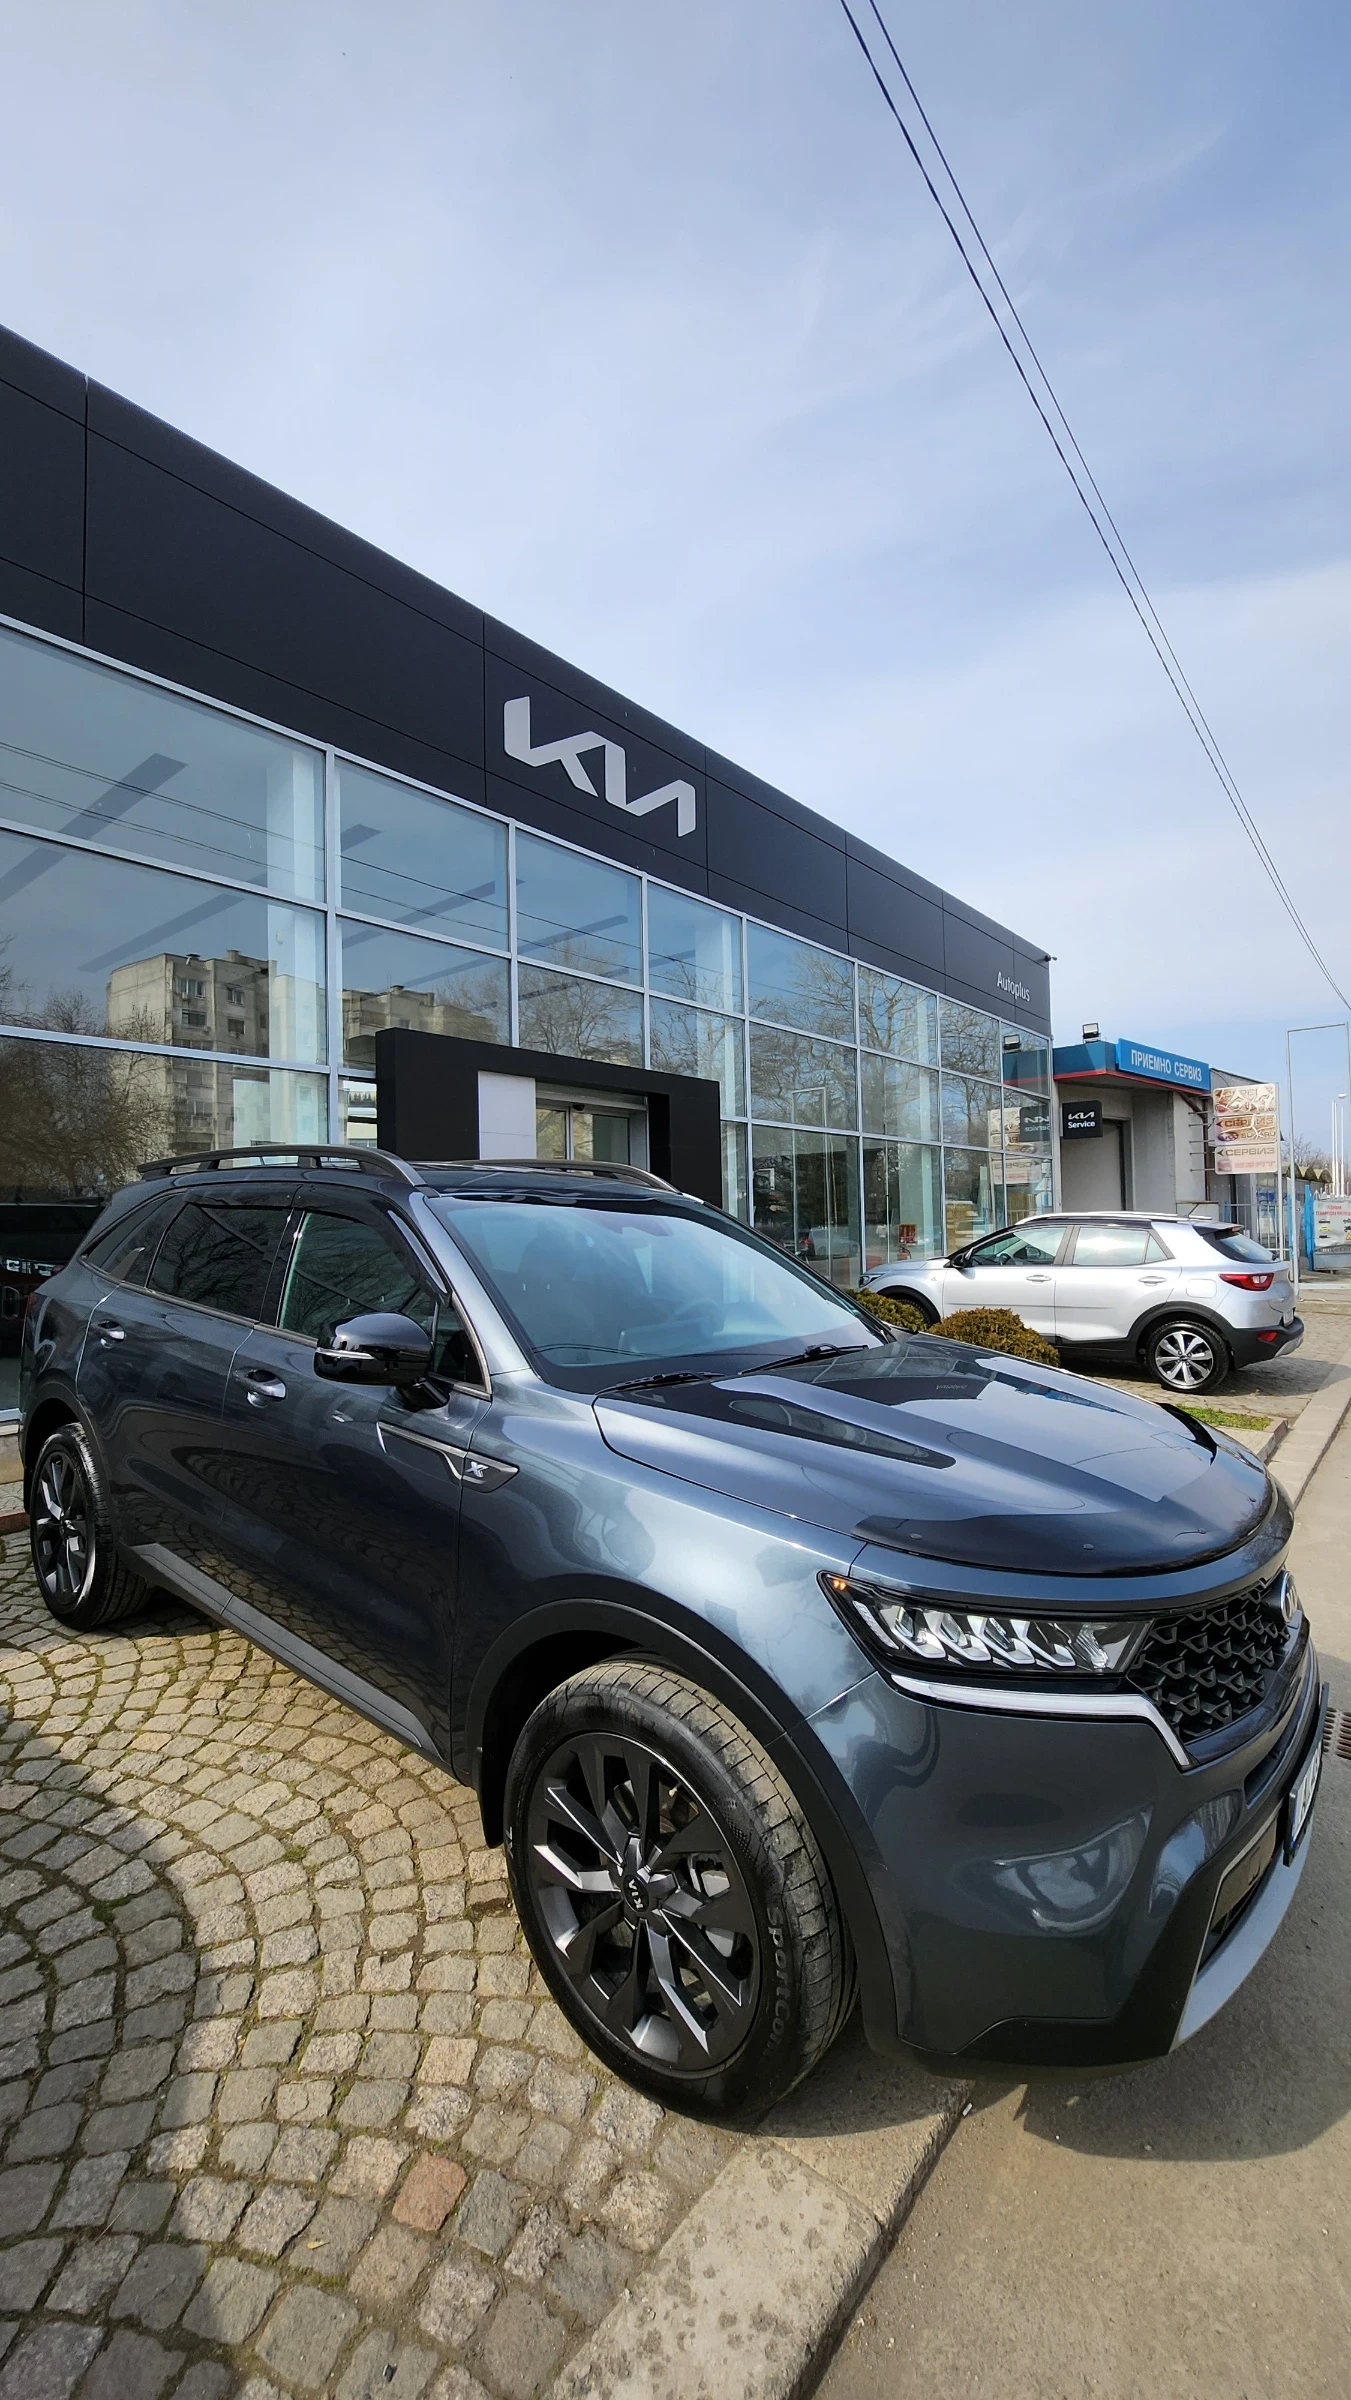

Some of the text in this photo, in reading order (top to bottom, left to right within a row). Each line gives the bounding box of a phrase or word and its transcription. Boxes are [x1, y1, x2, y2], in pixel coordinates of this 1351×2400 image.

[504, 696, 696, 838] KIA
[997, 971, 1030, 1002] Autoplus
[1131, 1049, 1202, 1082] ПРИЕМНО СЕРВИЗ
[1067, 1111, 1095, 1120] KIA
[1067, 1120, 1096, 1129] Service
[1240, 1131, 1276, 1139] SUARU
[1225, 1147, 1275, 1157] СЕРВИЗ
[628, 1879, 644, 1909] KIA
